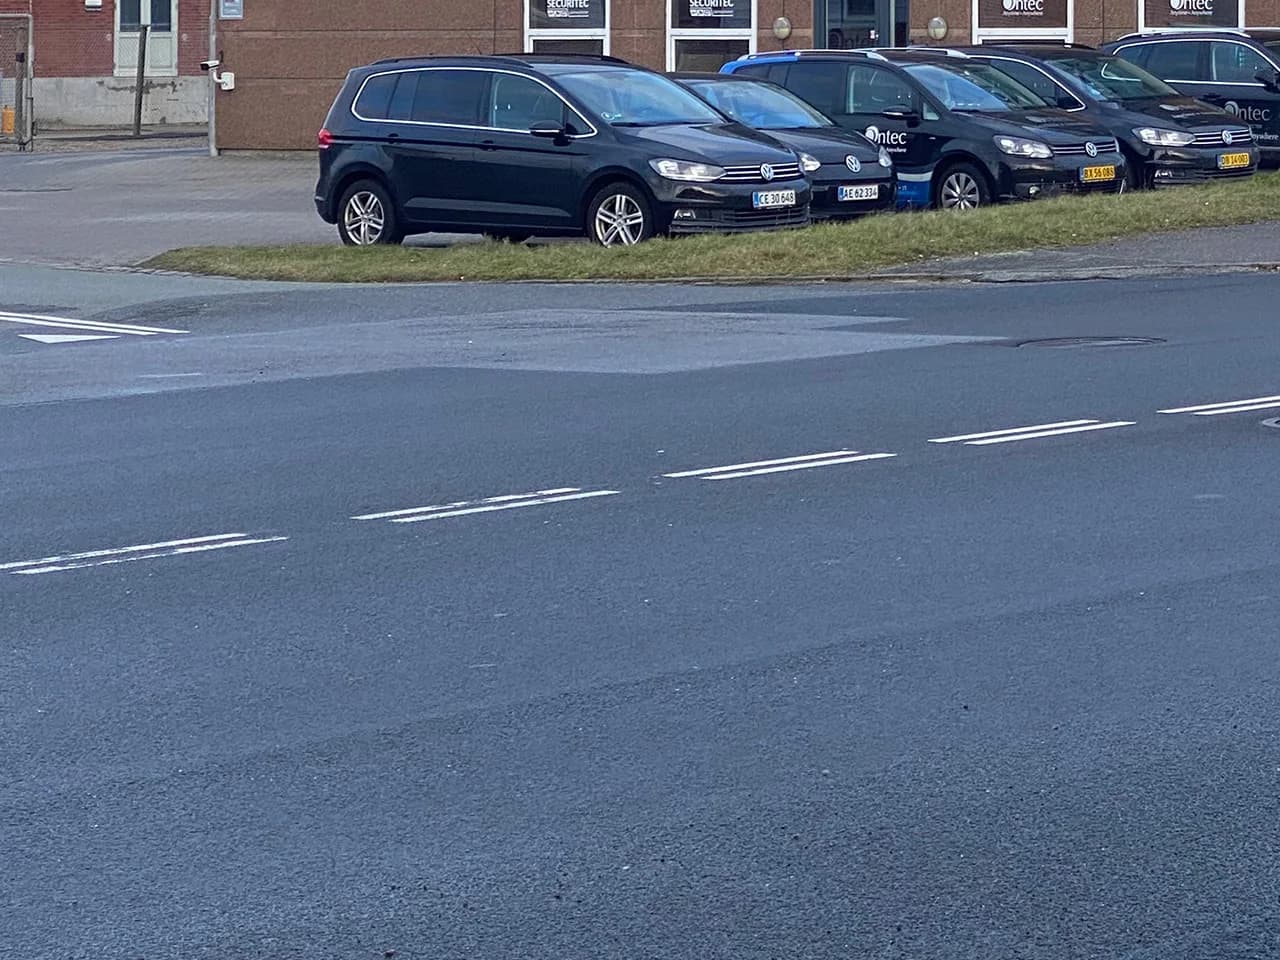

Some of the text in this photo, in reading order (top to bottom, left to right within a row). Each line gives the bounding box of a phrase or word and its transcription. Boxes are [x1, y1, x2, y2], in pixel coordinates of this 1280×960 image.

[1225, 101, 1270, 121] Ontec
[865, 126, 907, 144] Ontec
[759, 194, 769, 205] CE
